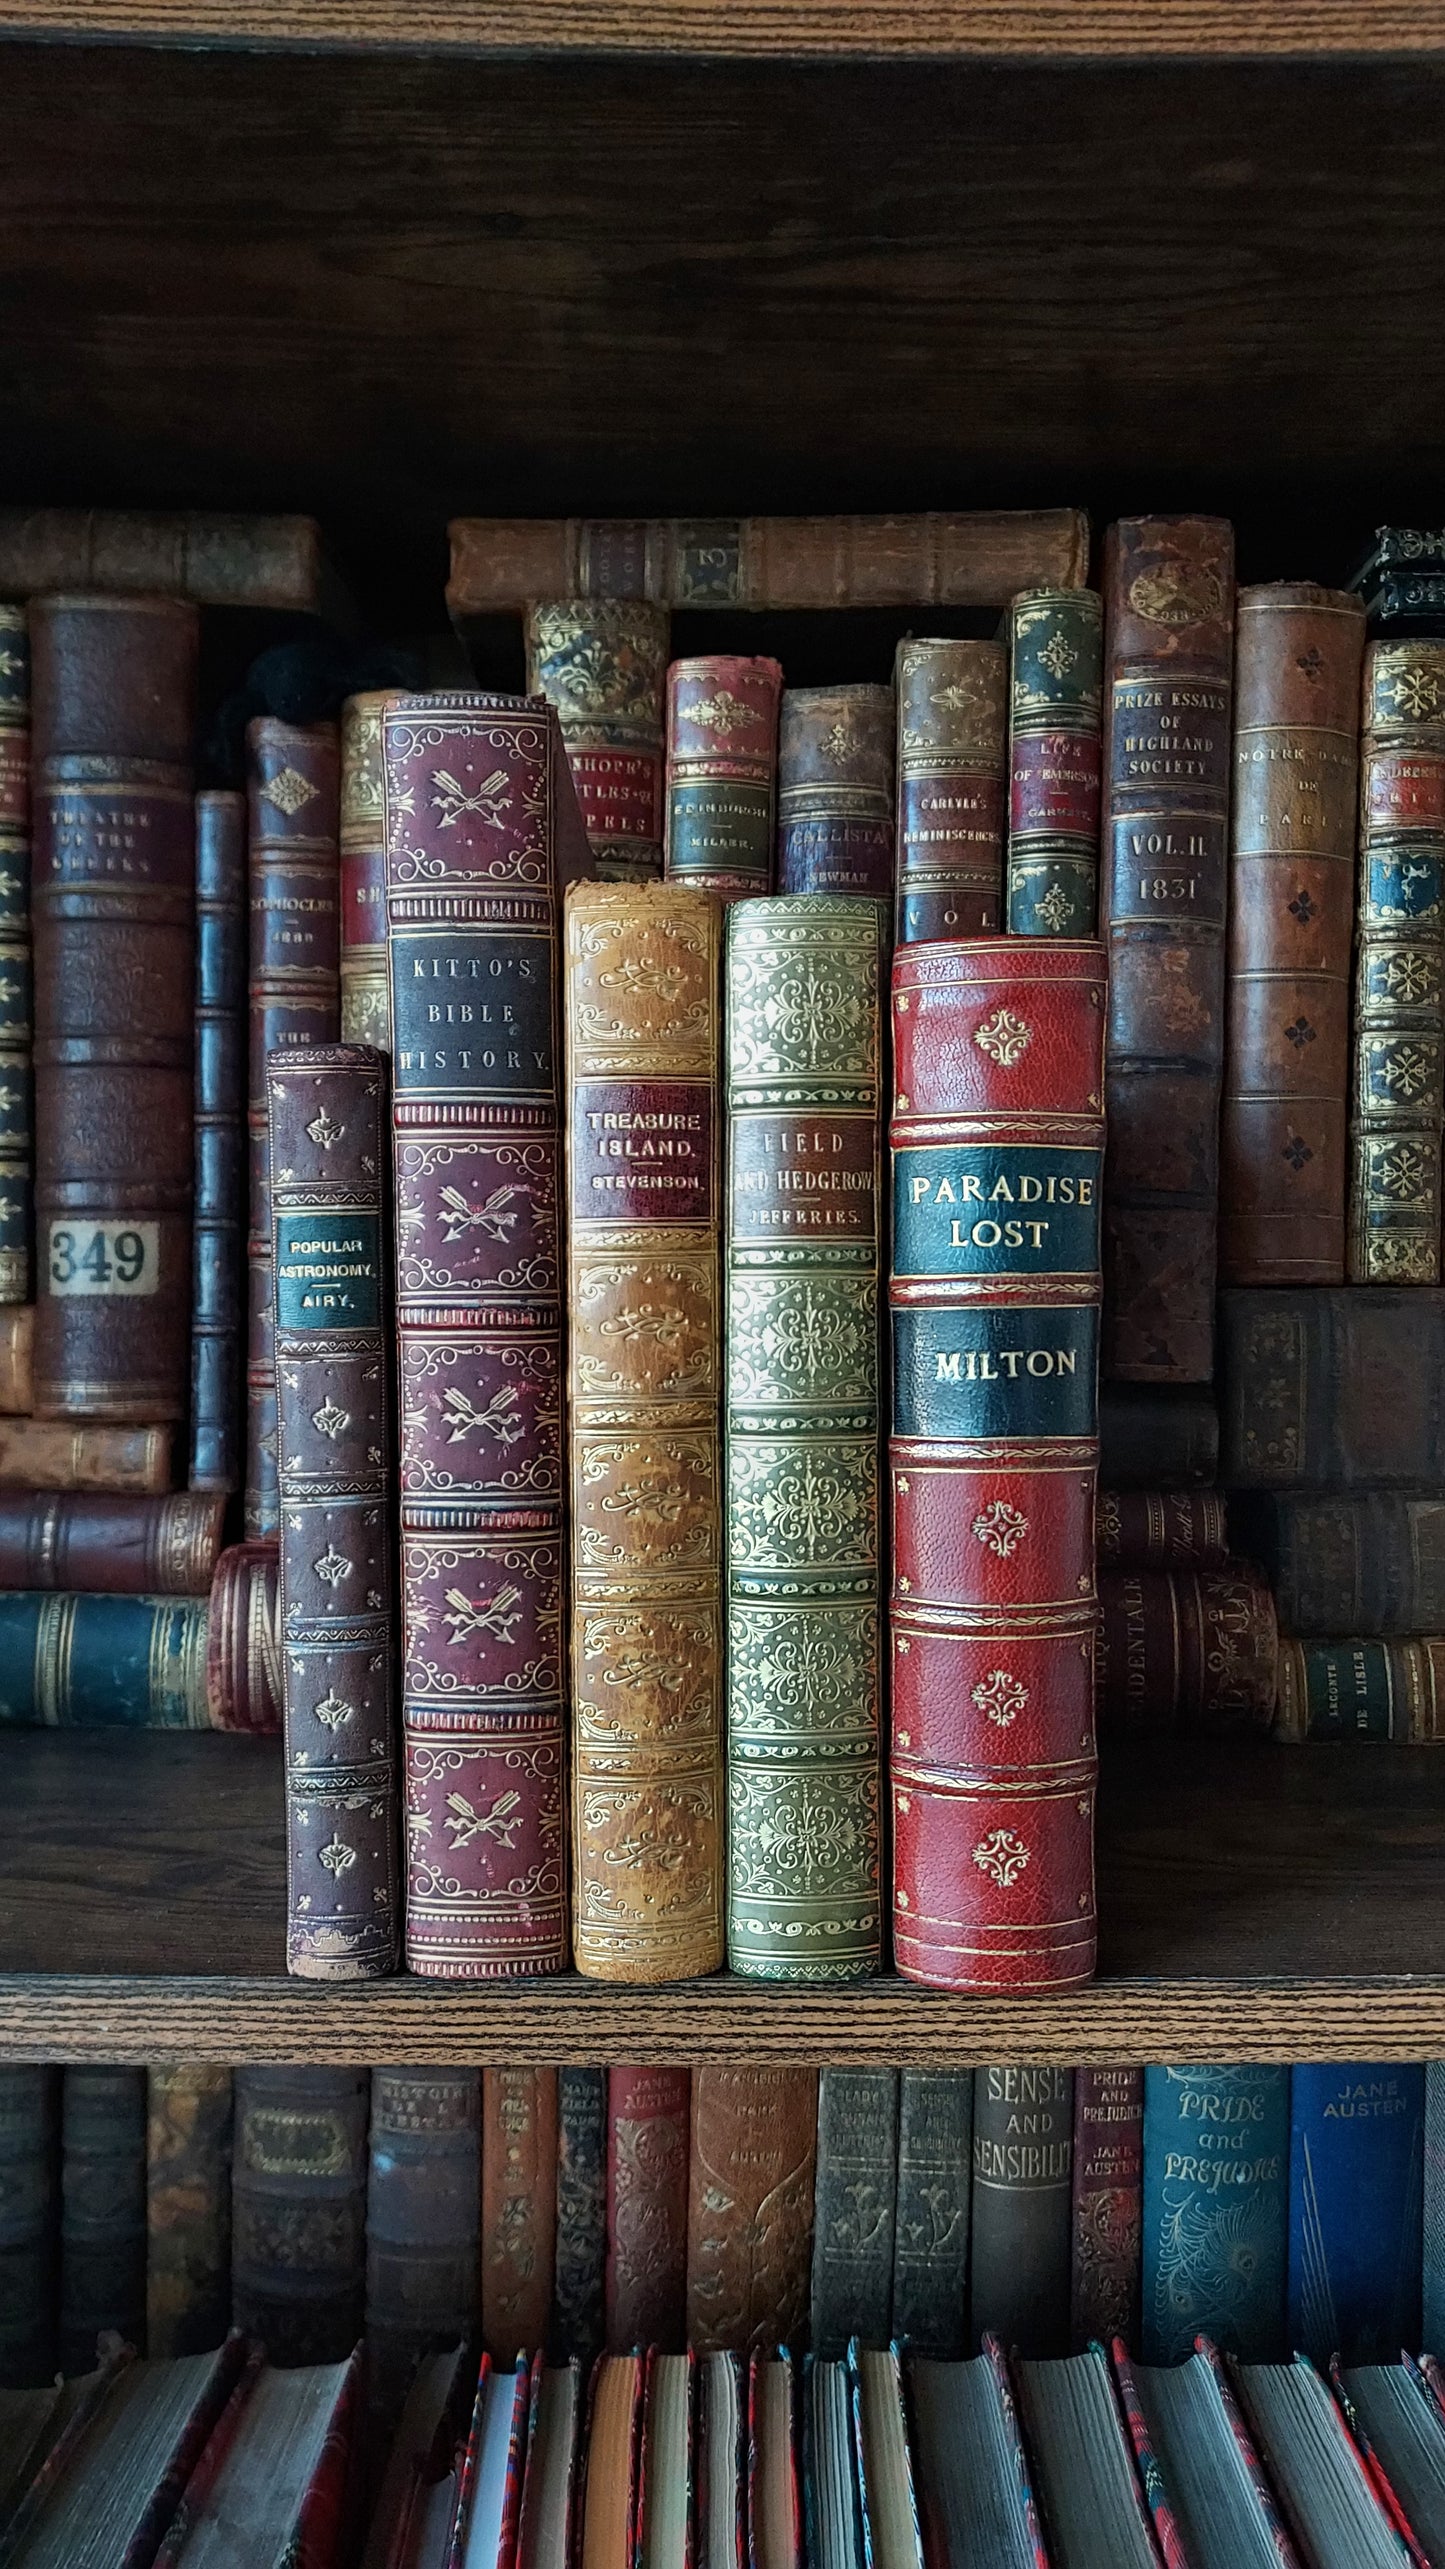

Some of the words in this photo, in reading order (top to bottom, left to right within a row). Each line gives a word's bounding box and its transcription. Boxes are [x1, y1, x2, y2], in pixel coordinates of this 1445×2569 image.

[1114, 692, 1163, 710] PRIZE
[1172, 692, 1226, 710] ESSAYS
[1160, 716, 1182, 729] OF
[1125, 737, 1214, 753] HIGHLAND
[1014, 769, 1034, 782] OF
[1129, 759, 1207, 775] SOCIETY
[1299, 780, 1319, 792] DE
[673, 802, 768, 819] EDINBURGH
[920, 793, 988, 811] CARLYLE'S
[792, 827, 885, 846] CALLISTA
[903, 828, 1002, 844] REMINISCENCES
[1131, 834, 1185, 856] VOL.
[809, 871, 870, 883] NEWMAN
[356, 887, 381, 904] SH
[1139, 878, 1196, 900] 1831
[413, 958, 532, 978] KITTO'S
[427, 1003, 515, 1023] BIBLE
[399, 1050, 551, 1070] HISTORY.
[586, 1112, 701, 1131] TREASURE
[598, 1139, 696, 1158] ISLAND.
[764, 1132, 844, 1153] FIELD
[591, 1174, 706, 1191] STEVENSON.
[734, 1170, 769, 1191] AND
[910, 1174, 1094, 1207] PARADISE
[748, 1209, 861, 1225] JEFFERIES.
[947, 1218, 1050, 1249] LOST
[52, 1229, 145, 1282] 349
[289, 1239, 363, 1254] POPULAR
[278, 1263, 377, 1279] ASTRONOMY.
[302, 1293, 355, 1309] AIRY.
[933, 1348, 1077, 1382] MILTON
[1352, 1650, 1368, 1696] LISLE
[1326, 1663, 1339, 1717] LECONTE
[1356, 1708, 1369, 1729] DE
[987, 2066, 1066, 2105] SENSE
[1093, 2070, 1138, 2087] PRIDE
[844, 2089, 880, 2102] LADY
[1100, 2089, 1129, 2102] AND
[1337, 2079, 1398, 2100] JANE
[1083, 2104, 1144, 2122] PREJUDICE
[1178, 2090, 1266, 2123] PRIDE
[1322, 2096, 1408, 2118] AUSTEN
[1005, 2112, 1053, 2134] AND
[1198, 2128, 1251, 2150] and
[973, 2135, 1071, 2181] SENSIBILIT
[1093, 2146, 1134, 2159] JANE
[1084, 2159, 1141, 2177] AUSTEN
[1163, 2151, 1281, 2196] PREJUDICE
